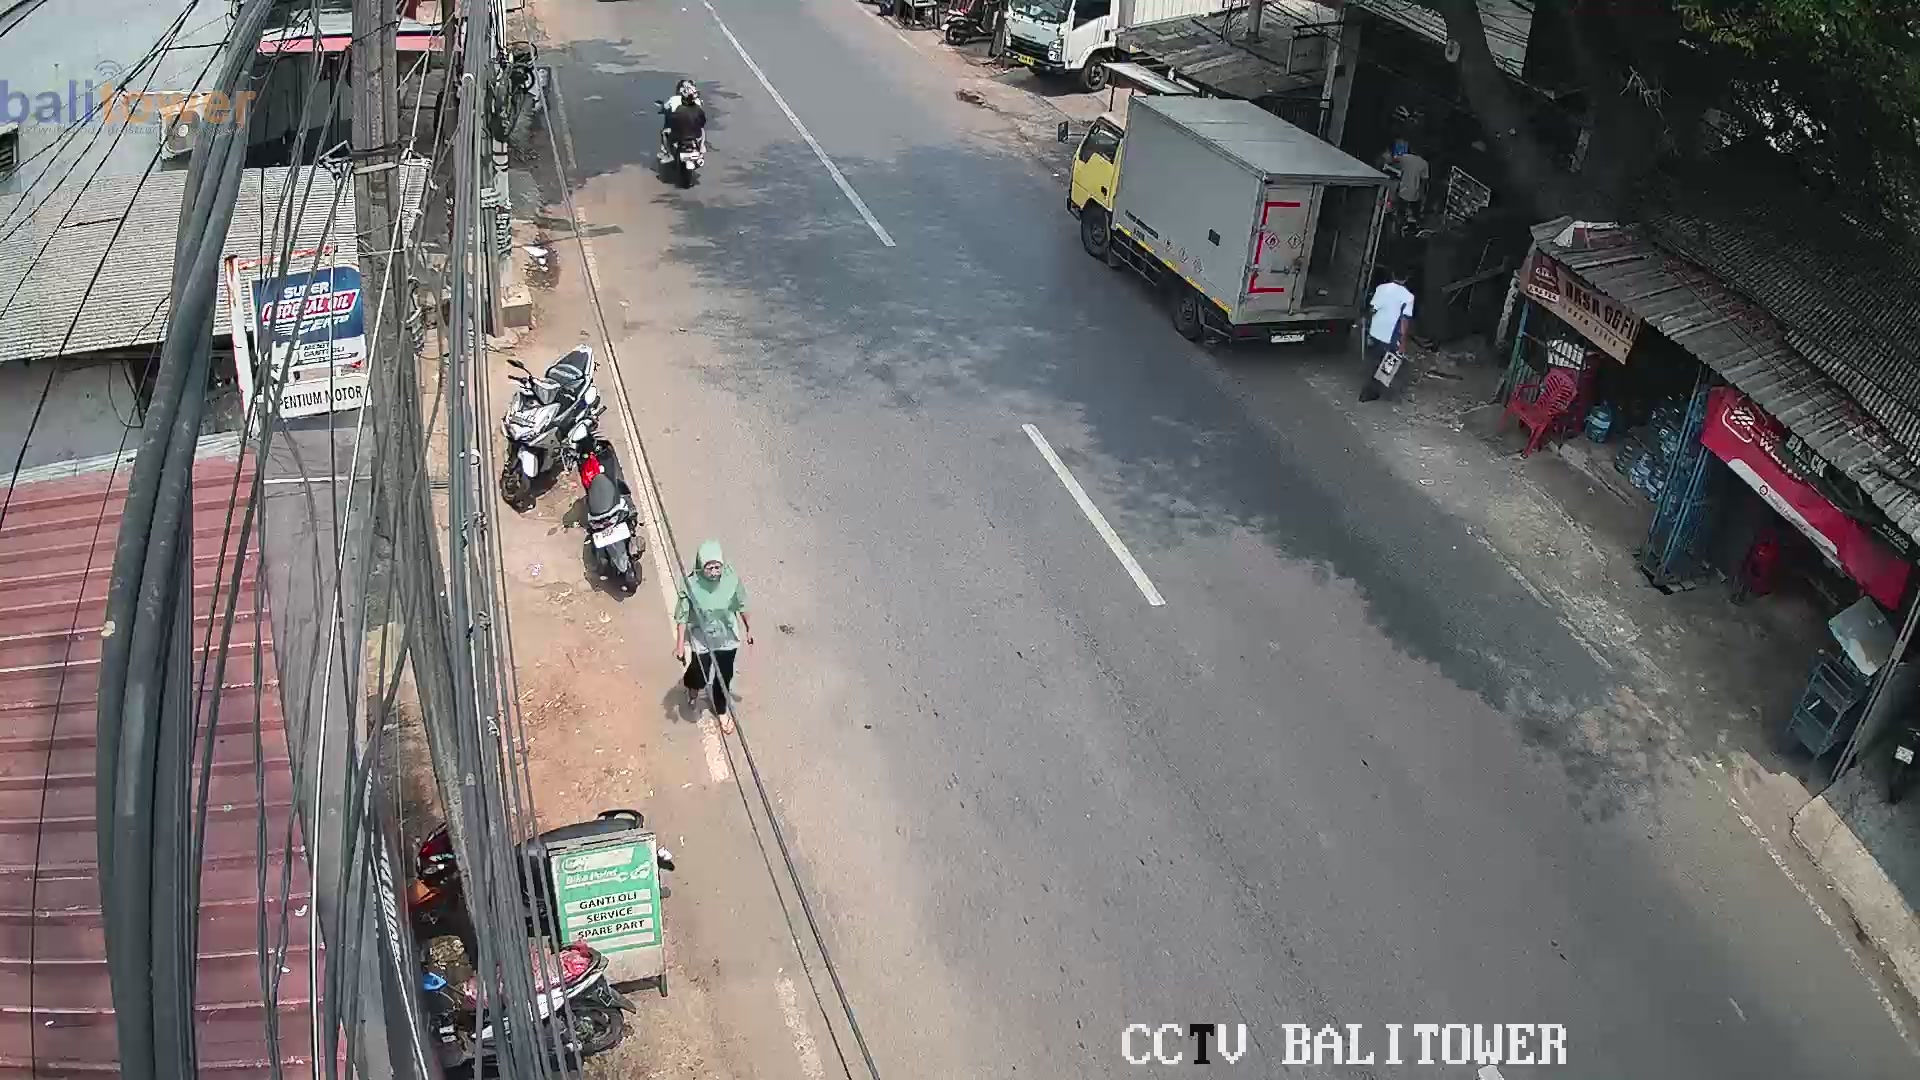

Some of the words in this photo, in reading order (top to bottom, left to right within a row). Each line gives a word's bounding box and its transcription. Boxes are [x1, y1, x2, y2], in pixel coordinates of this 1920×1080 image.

[284, 281, 330, 299] SUER
[579, 895, 615, 910] GANTI
[618, 891, 638, 902] OLI
[586, 906, 633, 923] SERVICE
[577, 925, 613, 939] SPARE
[615, 919, 645, 932] PART
